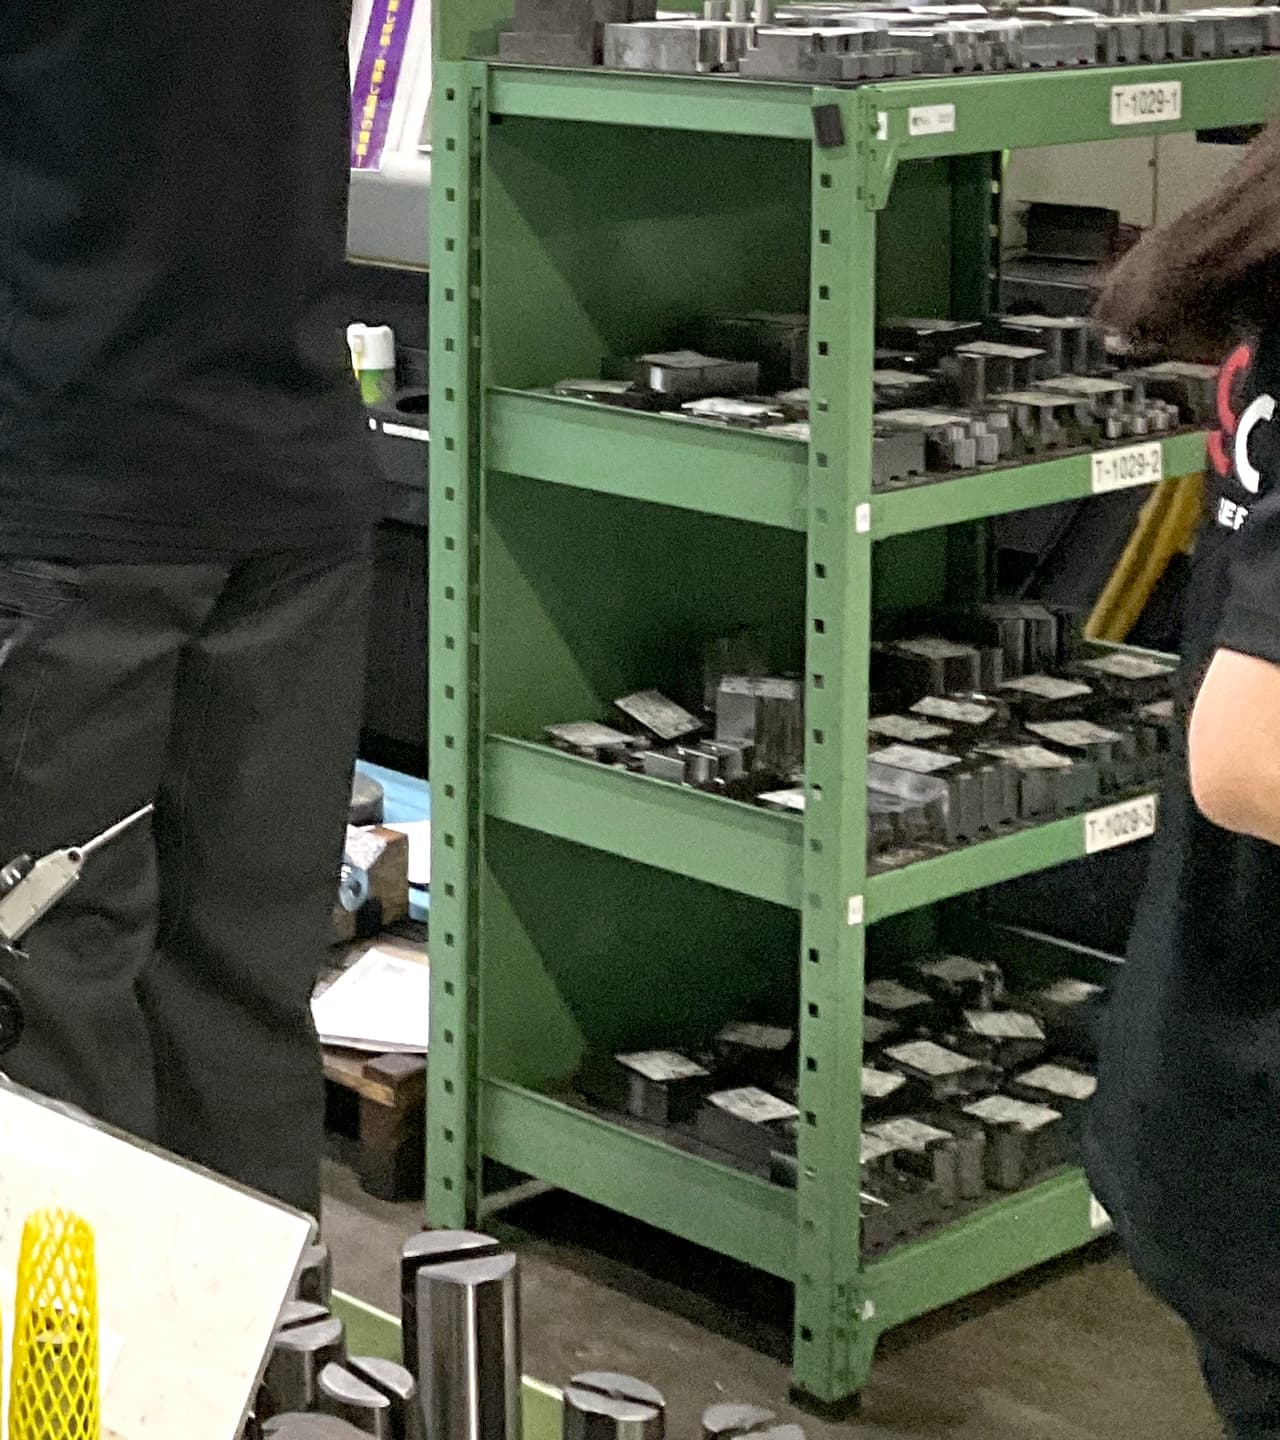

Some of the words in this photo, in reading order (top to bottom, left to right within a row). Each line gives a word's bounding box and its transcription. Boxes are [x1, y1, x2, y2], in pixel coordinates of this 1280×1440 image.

[1115, 88, 1178, 120] T-1029-1
[1095, 449, 1159, 484] T-1029-2
[1088, 803, 1154, 843] T-1029-3
